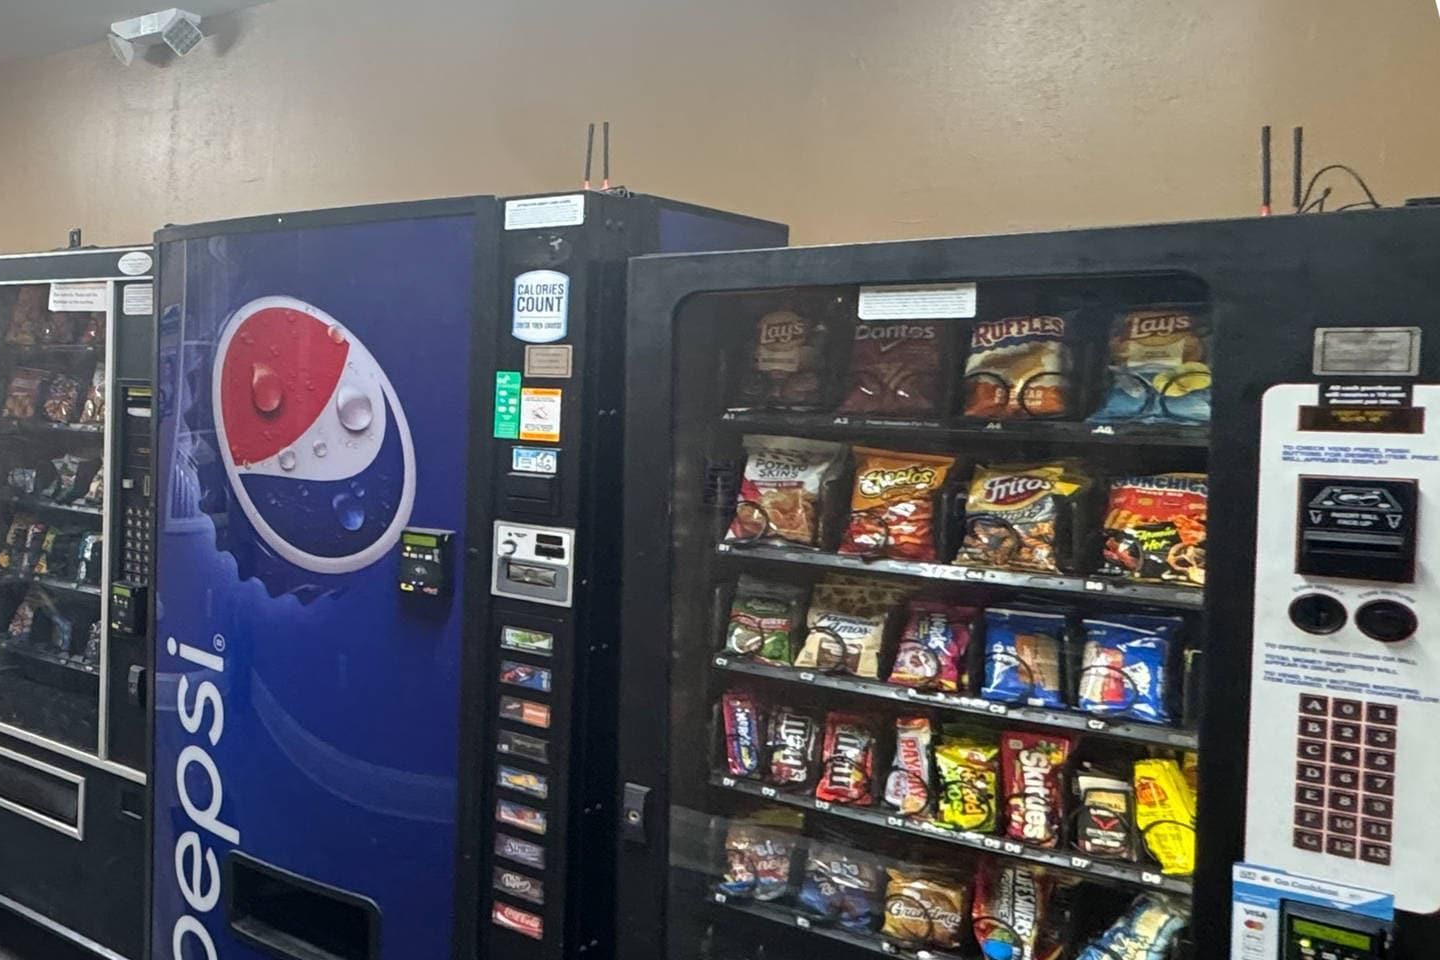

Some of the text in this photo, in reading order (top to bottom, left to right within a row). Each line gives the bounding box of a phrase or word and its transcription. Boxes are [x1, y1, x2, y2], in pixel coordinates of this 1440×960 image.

[517, 283, 564, 296] CALORIES
[517, 296, 564, 313] COUNT
[855, 324, 936, 340] Doritos
[972, 316, 1064, 348] RUFFLES
[756, 458, 808, 472] POTATO
[759, 469, 799, 478] SKINS
[984, 475, 1051, 503] Fritos
[1143, 539, 1171, 552] Hot
[822, 621, 872, 635] Amos
[1308, 700, 1322, 711] A
[1378, 709, 1388, 719] 1
[1307, 722, 1321, 733] B
[1341, 727, 1354, 738] 2
[1375, 732, 1388, 743] 3
[1306, 745, 1321, 755] C
[1341, 751, 1353, 761] 4
[1374, 755, 1388, 766] 5
[900, 738, 928, 800] PAYDAY
[1305, 767, 1320, 778] D
[722, 777, 736, 787] D1
[1339, 773, 1352, 783] 6
[1374, 778, 1387, 788] 7
[762, 786, 776, 796] D2
[1020, 750, 1051, 840] Skittles
[1305, 790, 1319, 801] E
[815, 801, 830, 810] D3
[1339, 796, 1352, 806] 8
[1305, 812, 1317, 822] F
[1335, 818, 1354, 829] 10
[1371, 824, 1388, 835] 11
[1303, 835, 1318, 846] G
[1335, 840, 1353, 852] 12
[1368, 847, 1388, 858] 13
[1244, 909, 1267, 919] VISA
